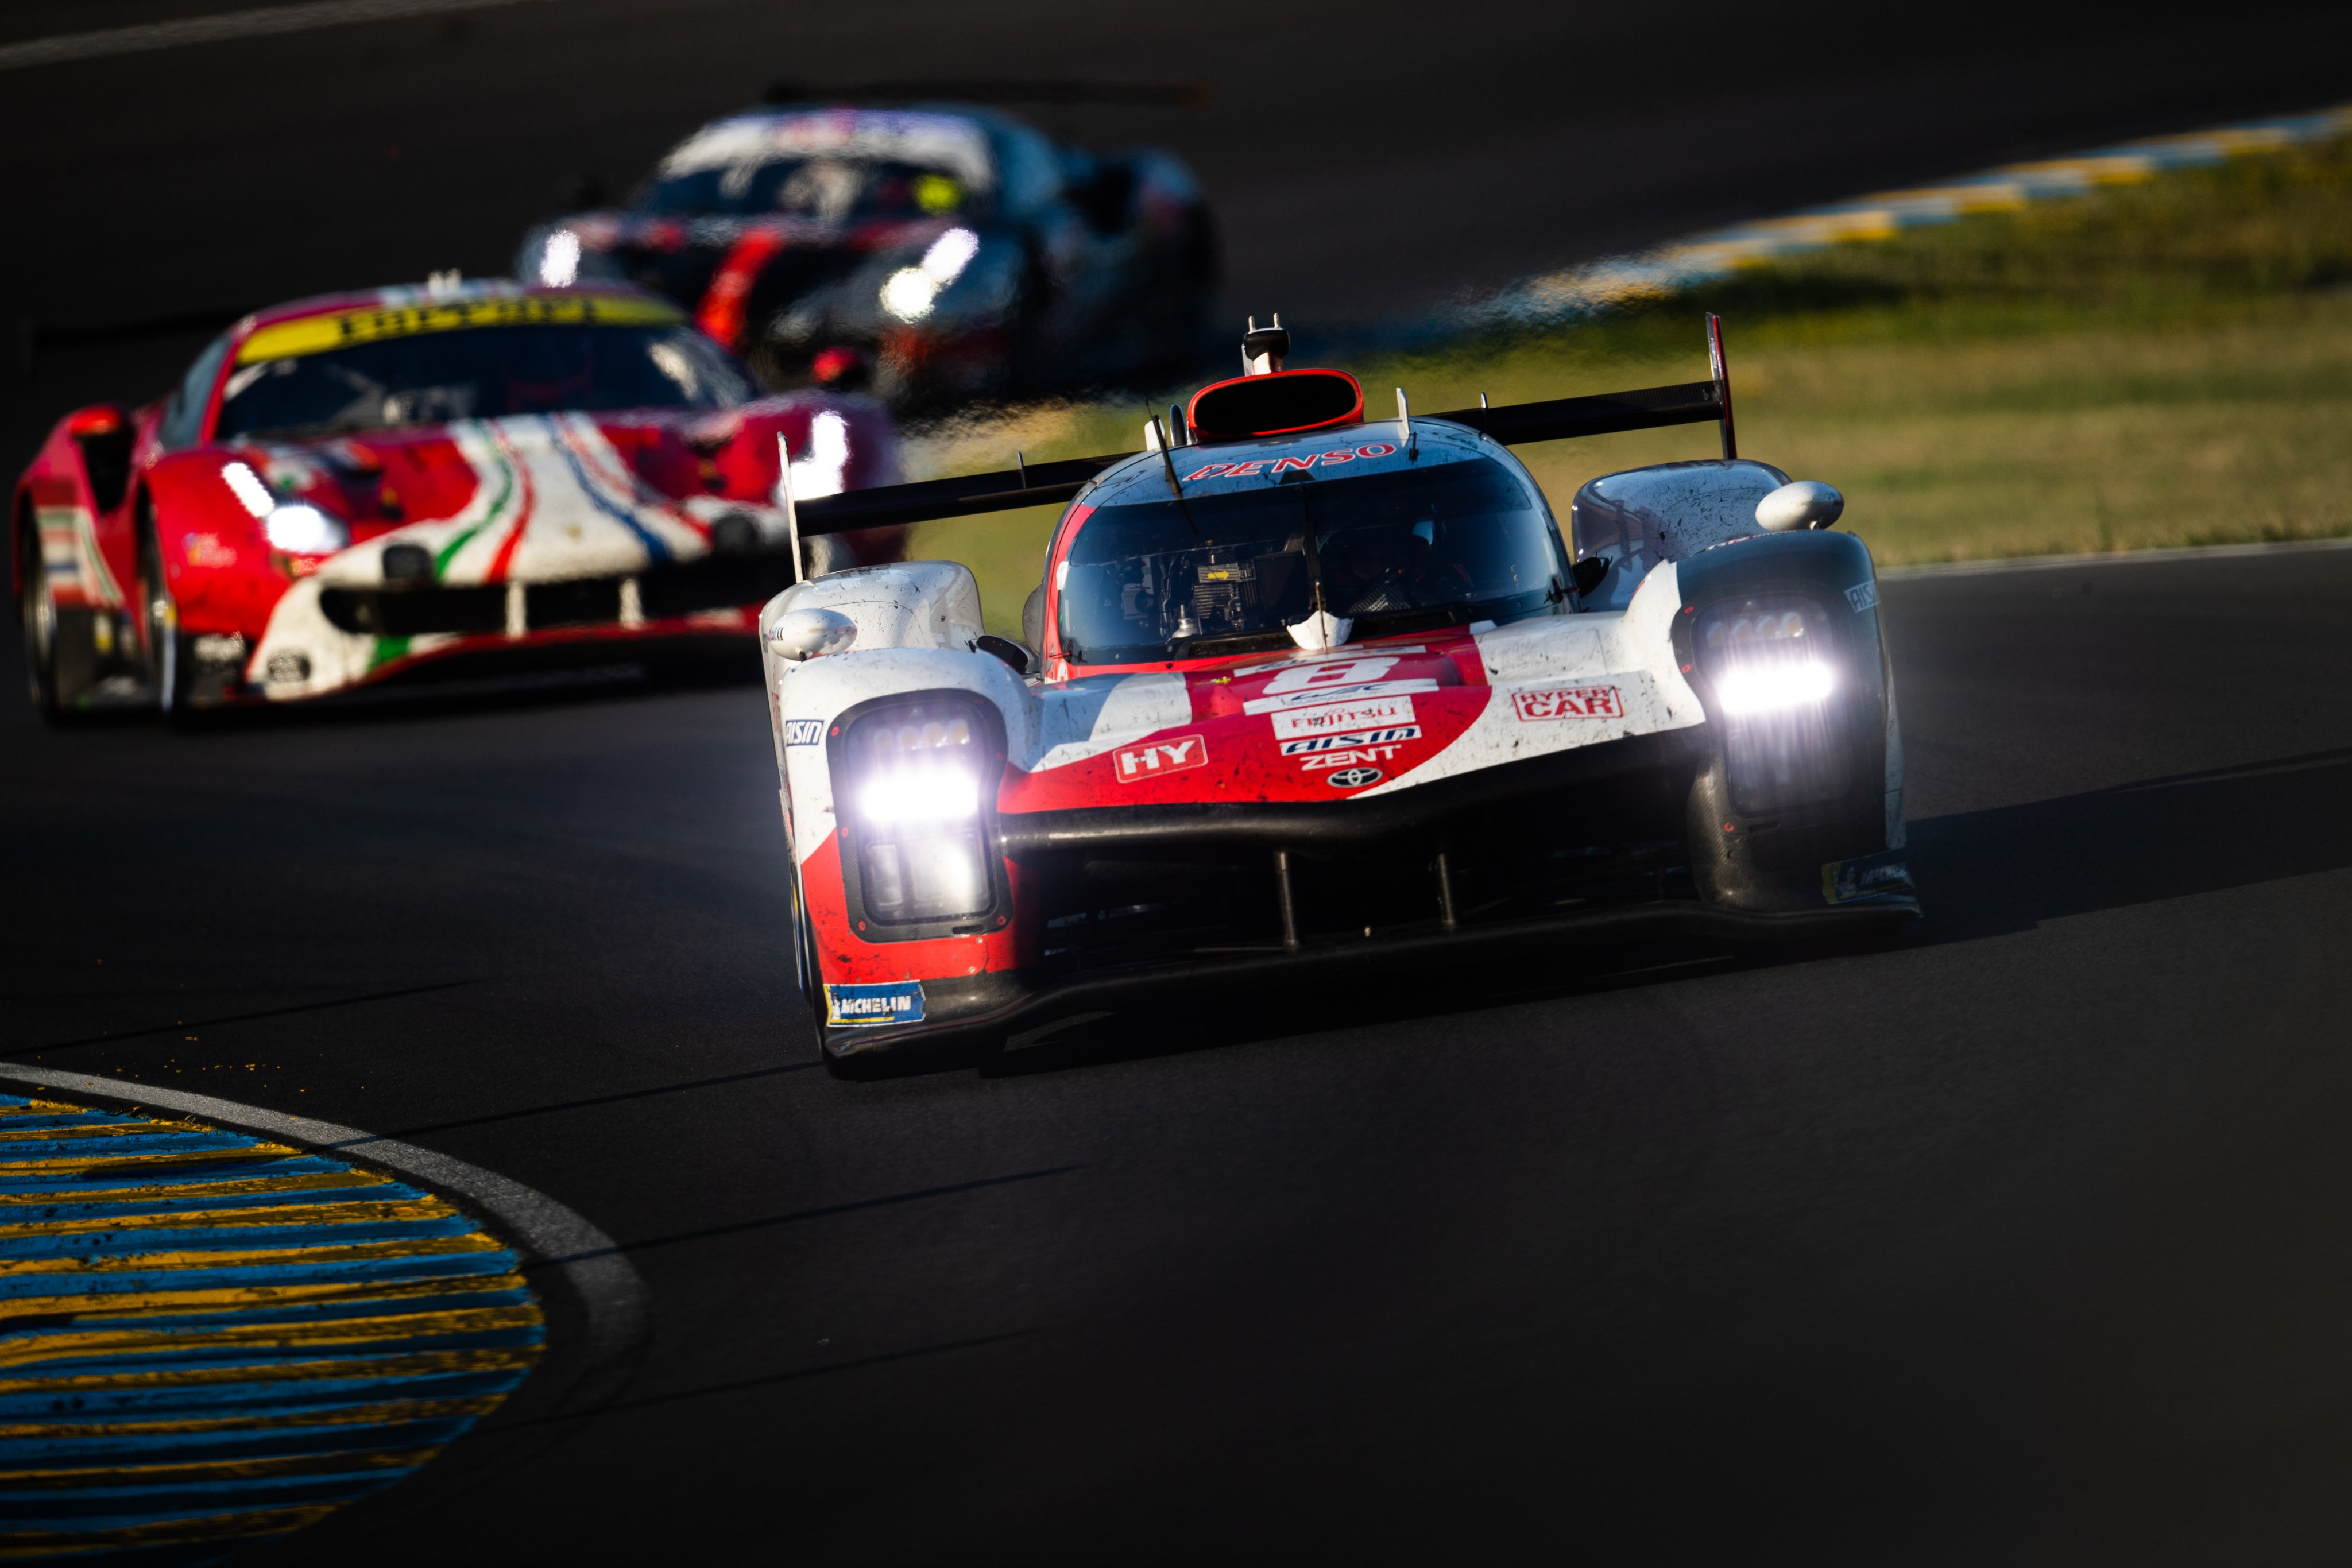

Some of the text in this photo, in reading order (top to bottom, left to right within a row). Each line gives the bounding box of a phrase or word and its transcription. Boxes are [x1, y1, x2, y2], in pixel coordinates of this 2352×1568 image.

[1182, 443, 1396, 481] DENSO
[1262, 656, 1400, 694] 8
[1521, 688, 1609, 702] HYPER
[1291, 707, 1395, 728] FUJITSU
[1524, 699, 1613, 717] CAR
[786, 721, 823, 744] AISIN
[1286, 727, 1416, 753] AISIN
[1120, 740, 1194, 776] HY
[1299, 744, 1402, 771] ZENT
[840, 995, 911, 1014] MICHELIN
